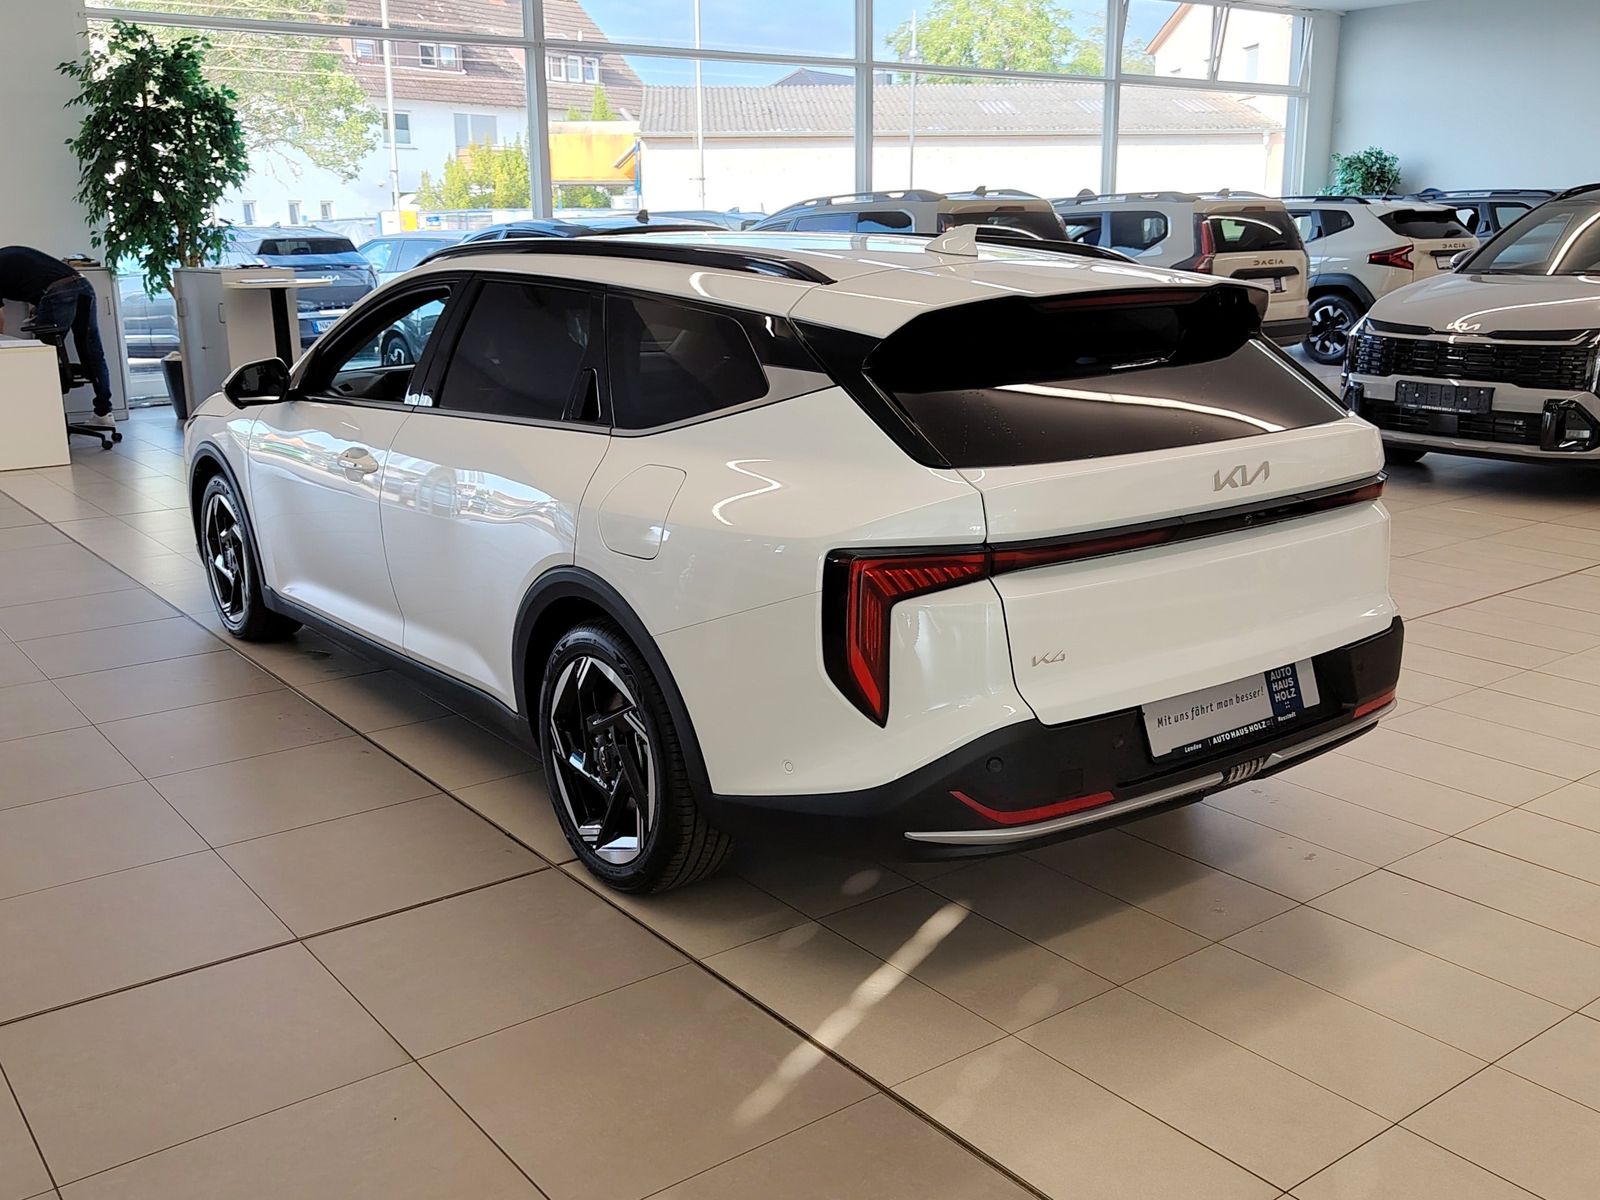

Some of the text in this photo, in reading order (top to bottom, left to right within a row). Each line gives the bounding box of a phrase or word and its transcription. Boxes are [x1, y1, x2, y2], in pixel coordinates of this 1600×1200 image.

[1213, 461, 1270, 492] KIA
[1032, 650, 1065, 667] K4
[1270, 667, 1292, 681] AUTO
[1272, 677, 1294, 692] HAUS
[1274, 688, 1297, 703] HOLZ
[1157, 686, 1265, 728] Mit uns fährt man besser!
[1248, 721, 1267, 733] HOLZ
